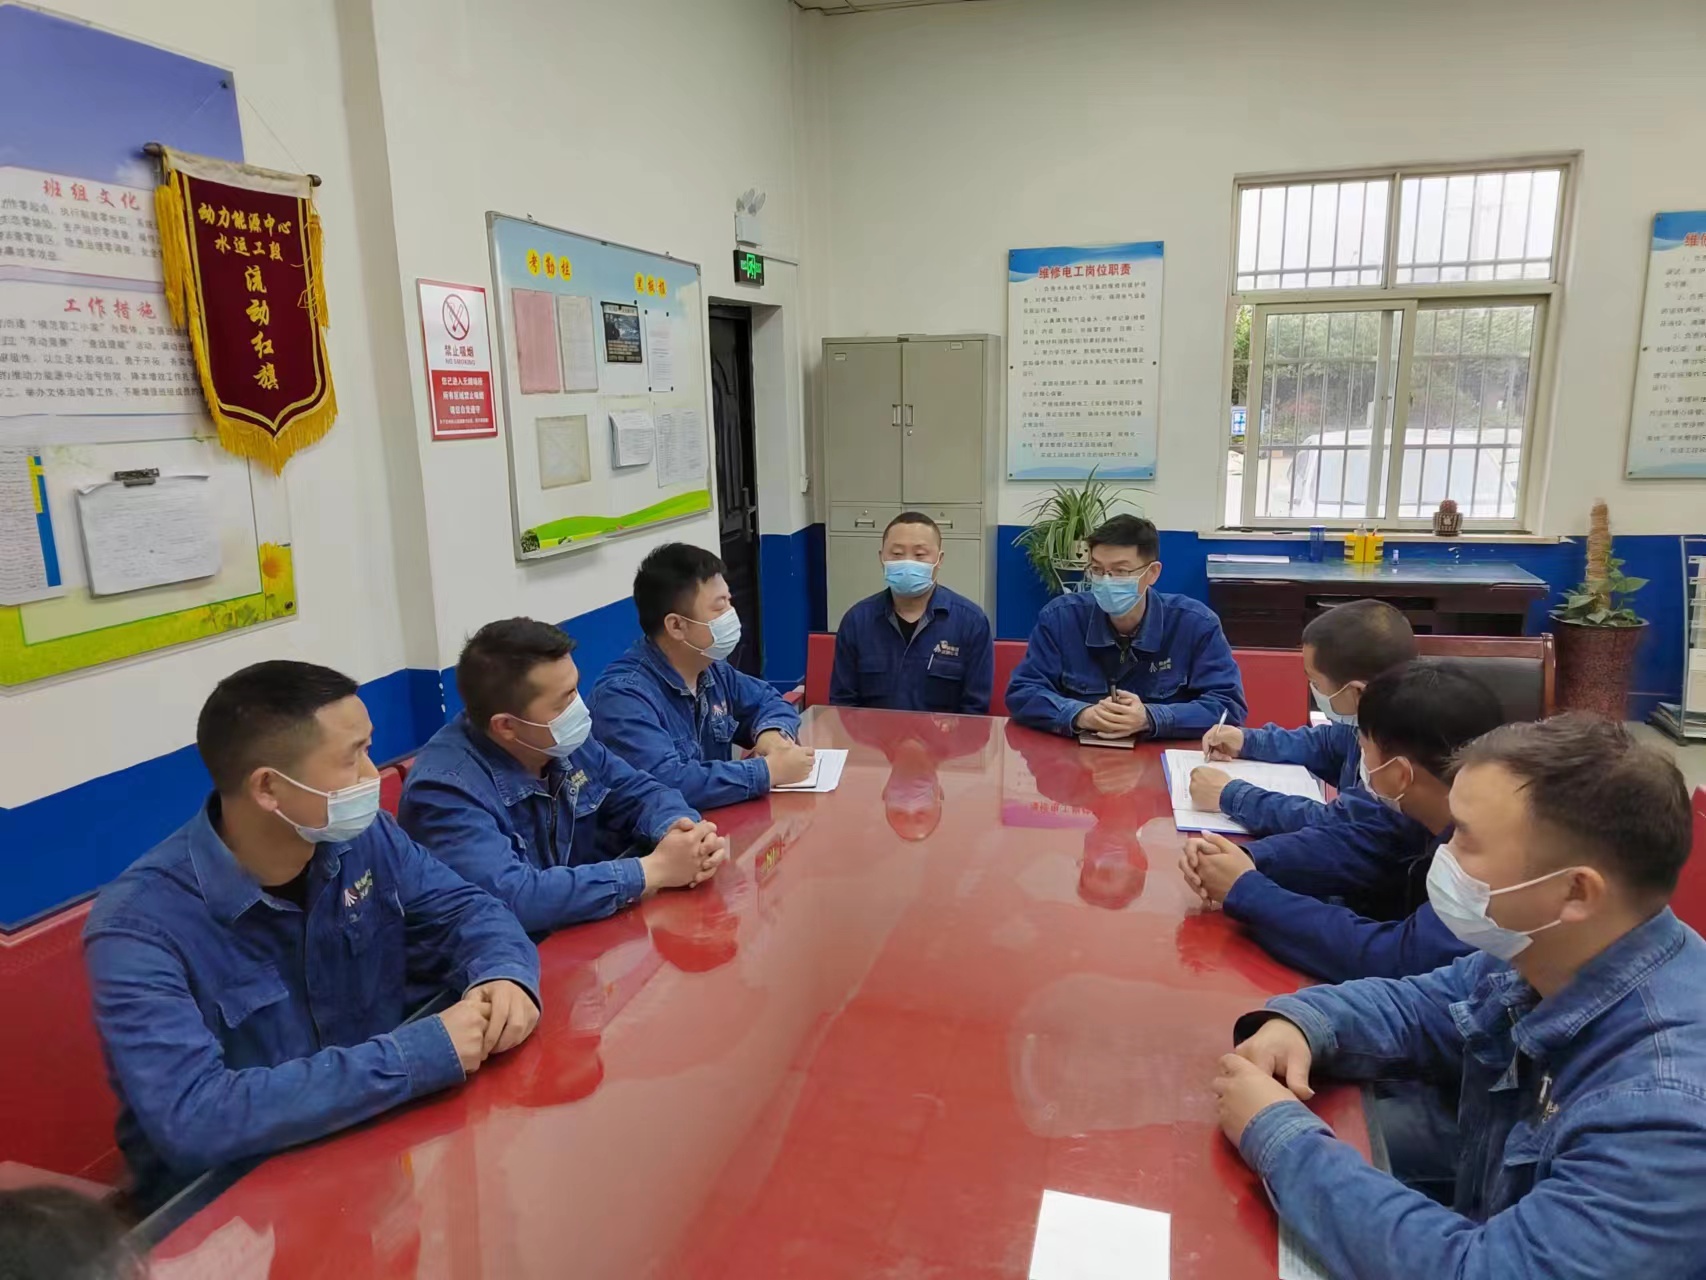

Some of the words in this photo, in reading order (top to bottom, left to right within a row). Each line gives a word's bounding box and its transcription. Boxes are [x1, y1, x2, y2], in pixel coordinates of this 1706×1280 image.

[42, 177, 141, 210] 班组文化
[198, 202, 292, 237] 动力能源中心
[214, 232, 284, 262] 水运工段
[1039, 263, 1132, 280] 维修电工岗位职责
[63, 297, 157, 319] 工作措施
[244, 264, 280, 390] 流动红旗
[444, 344, 474, 358] 禁止吸烟
